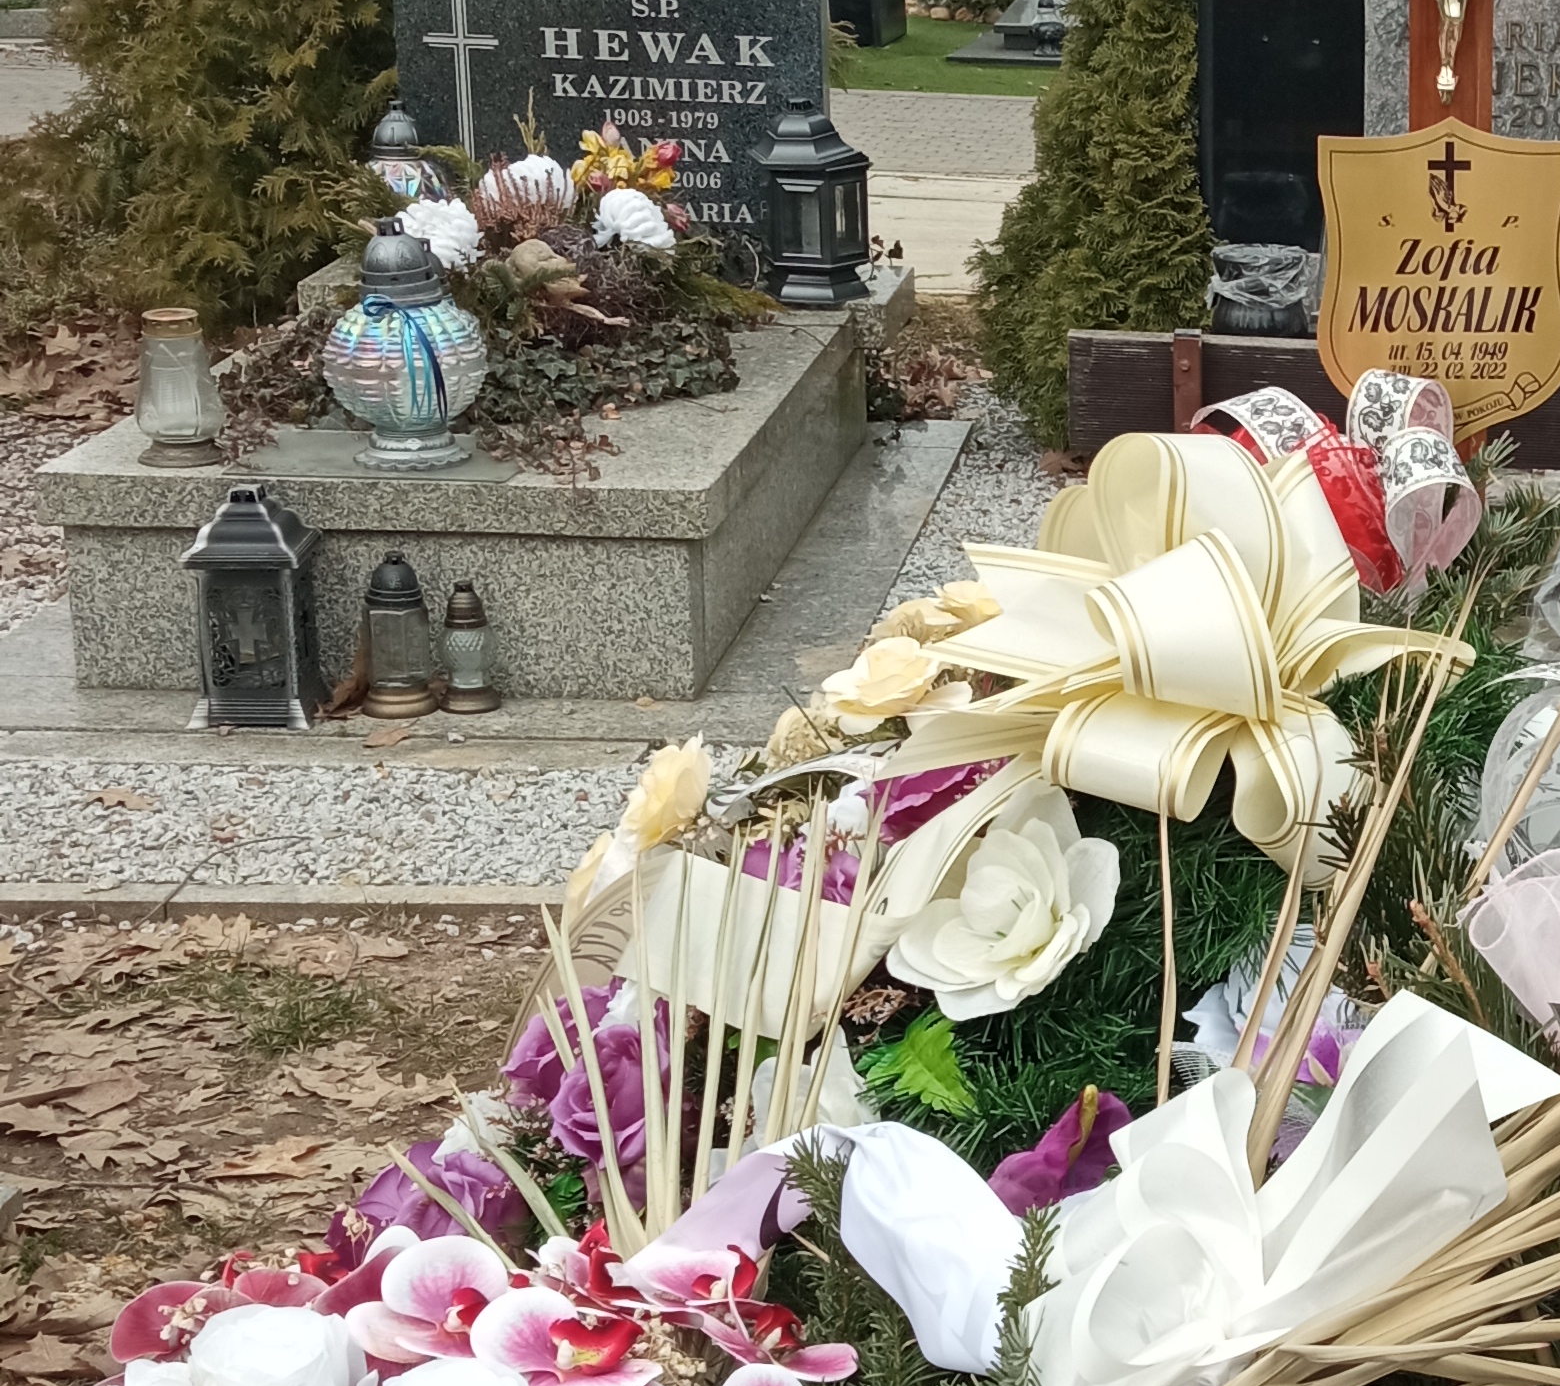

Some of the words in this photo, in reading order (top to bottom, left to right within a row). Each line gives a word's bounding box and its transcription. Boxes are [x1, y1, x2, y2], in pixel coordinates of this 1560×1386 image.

[539, 25, 777, 68] HEWAK
[551, 72, 768, 106] KAZIMIERZ
[1501, 215, 1520, 229] P.
[1395, 237, 1502, 282] Zofia
[1347, 284, 1544, 334] MOSKALIK
[1470, 341, 1509, 361] 1949
[1470, 362, 1508, 380] 2022
